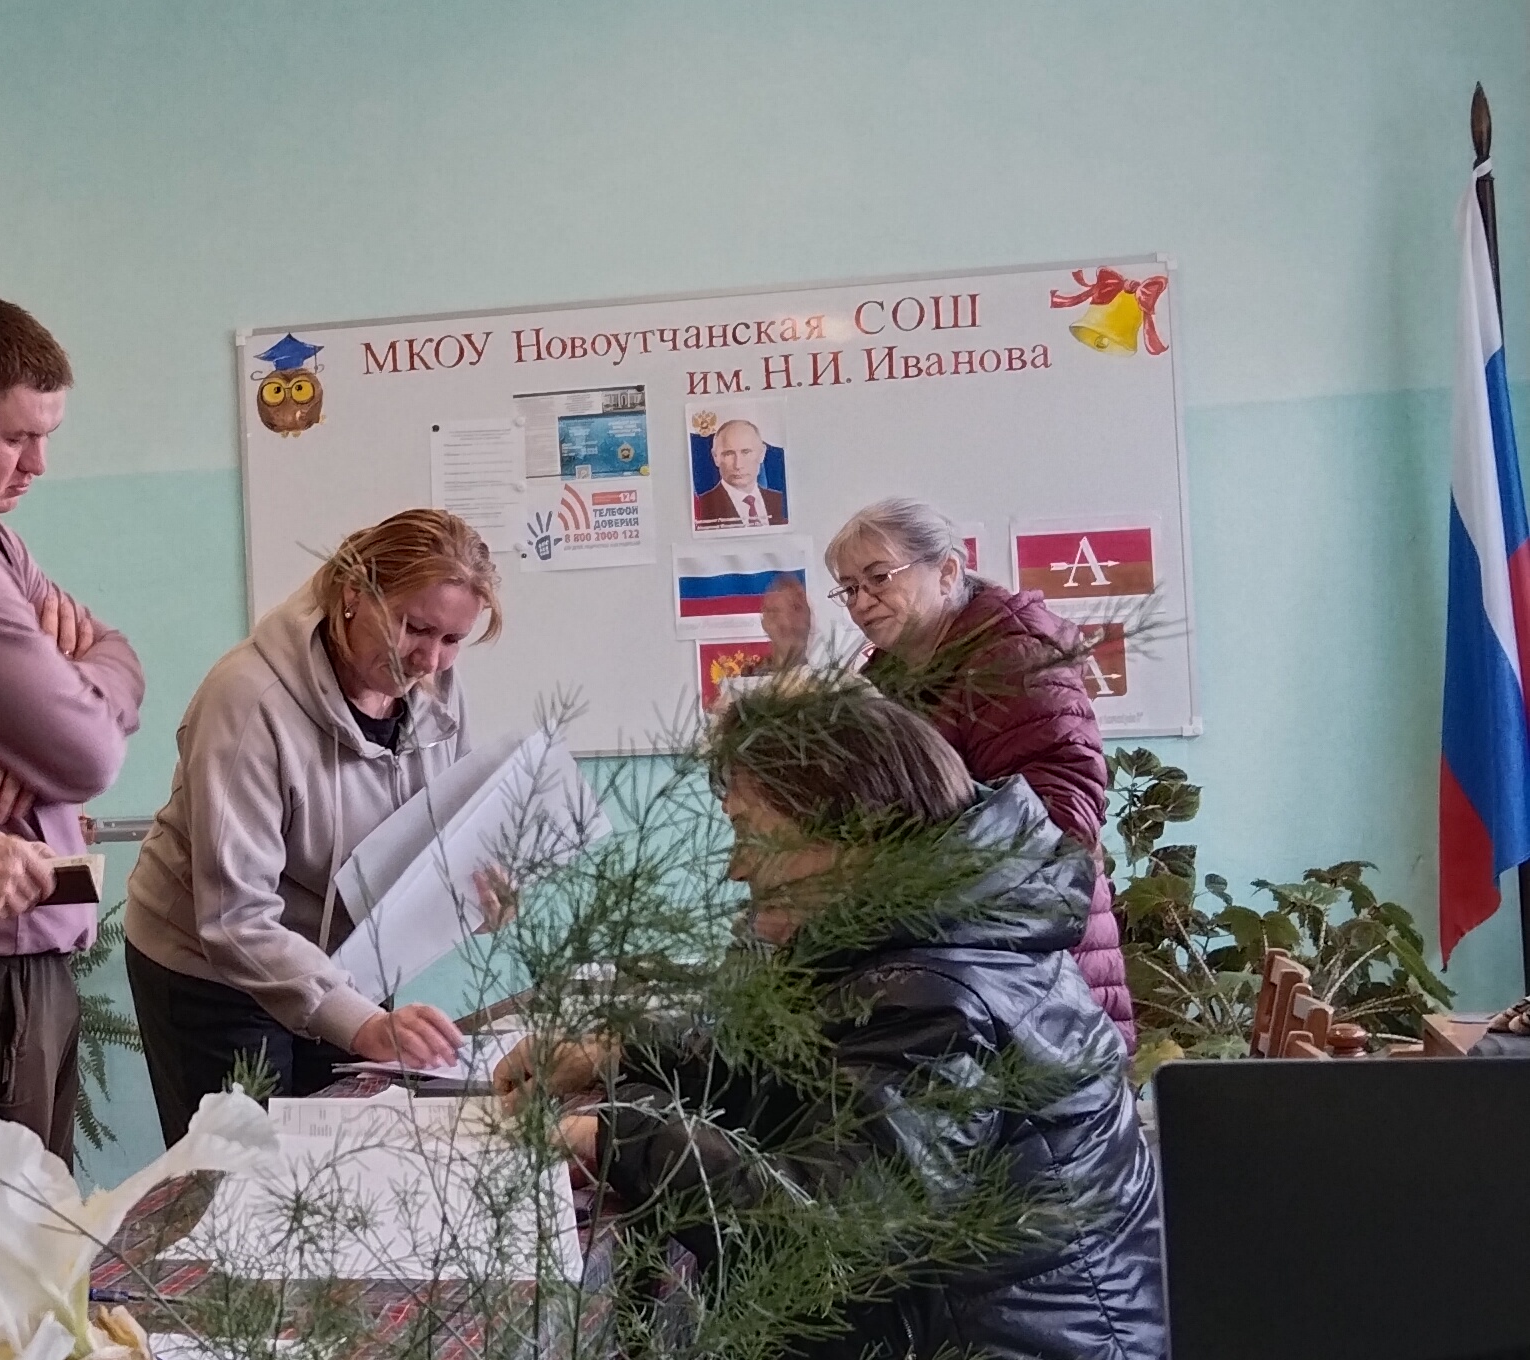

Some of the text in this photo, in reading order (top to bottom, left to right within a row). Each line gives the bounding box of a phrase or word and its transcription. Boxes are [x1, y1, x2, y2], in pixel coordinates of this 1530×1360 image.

[361, 293, 982, 375] МКОУ Новоутчанская СОШ
[685, 343, 1053, 395] им. Н.И. Иванова
[593, 506, 638, 518] ТЕЛЕФОН
[594, 518, 639, 530] ДОВЕРИЯ
